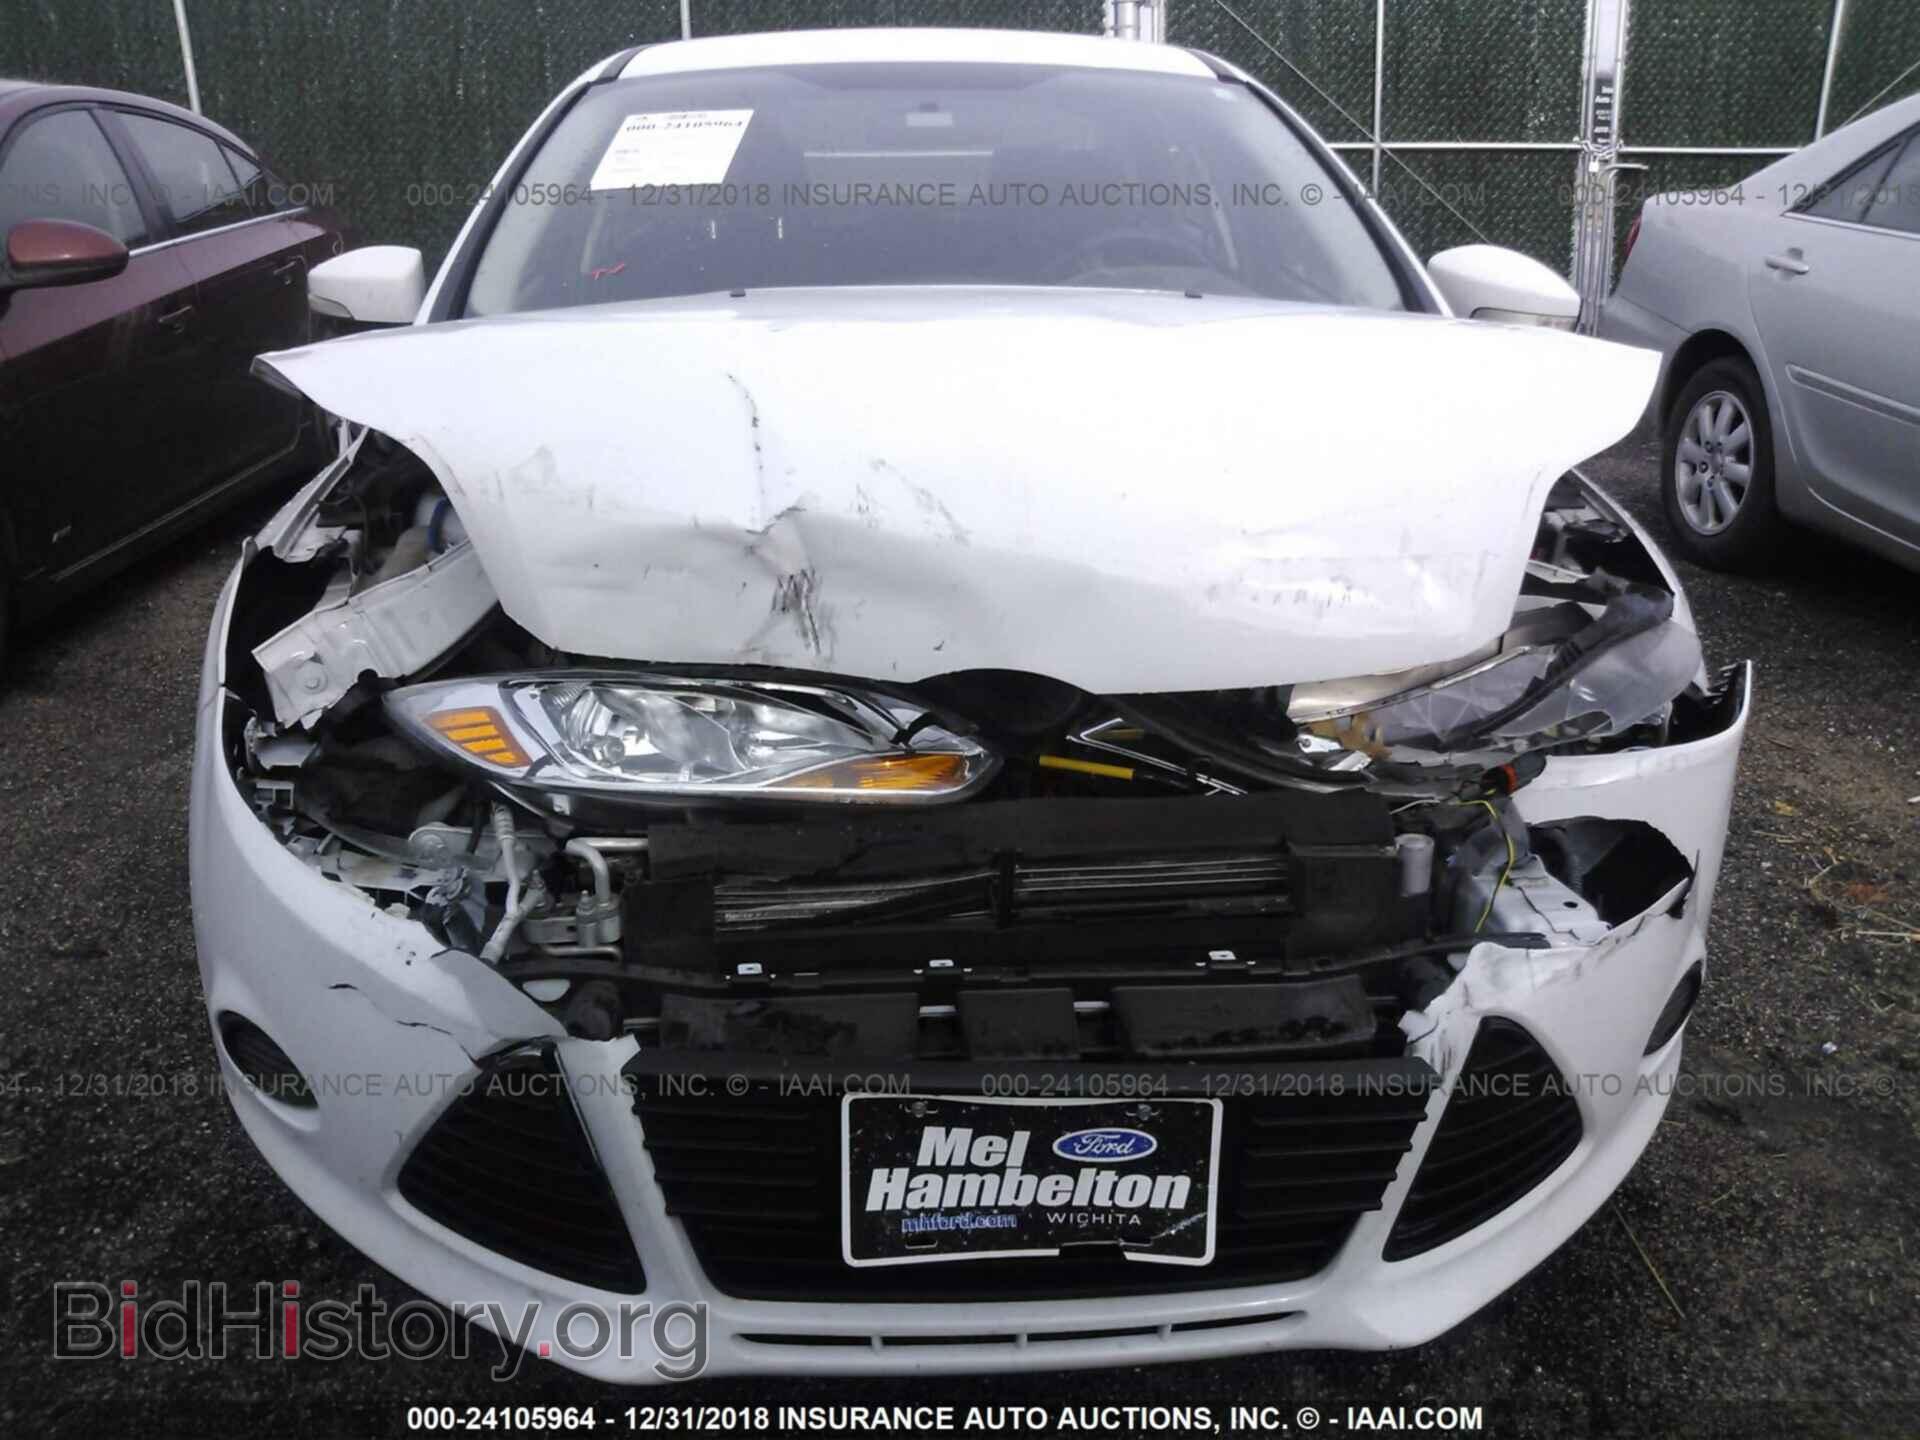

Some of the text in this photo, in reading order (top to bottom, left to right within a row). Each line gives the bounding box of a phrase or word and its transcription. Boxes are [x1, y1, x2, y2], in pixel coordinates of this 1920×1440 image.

[916, 1126, 1031, 1167] Mel
[1072, 1133, 1134, 1156] Ford
[865, 1167, 1191, 1211] Hambelton
[902, 1213, 1017, 1233] mhford.com
[1046, 1211, 1142, 1229] WICHITA
